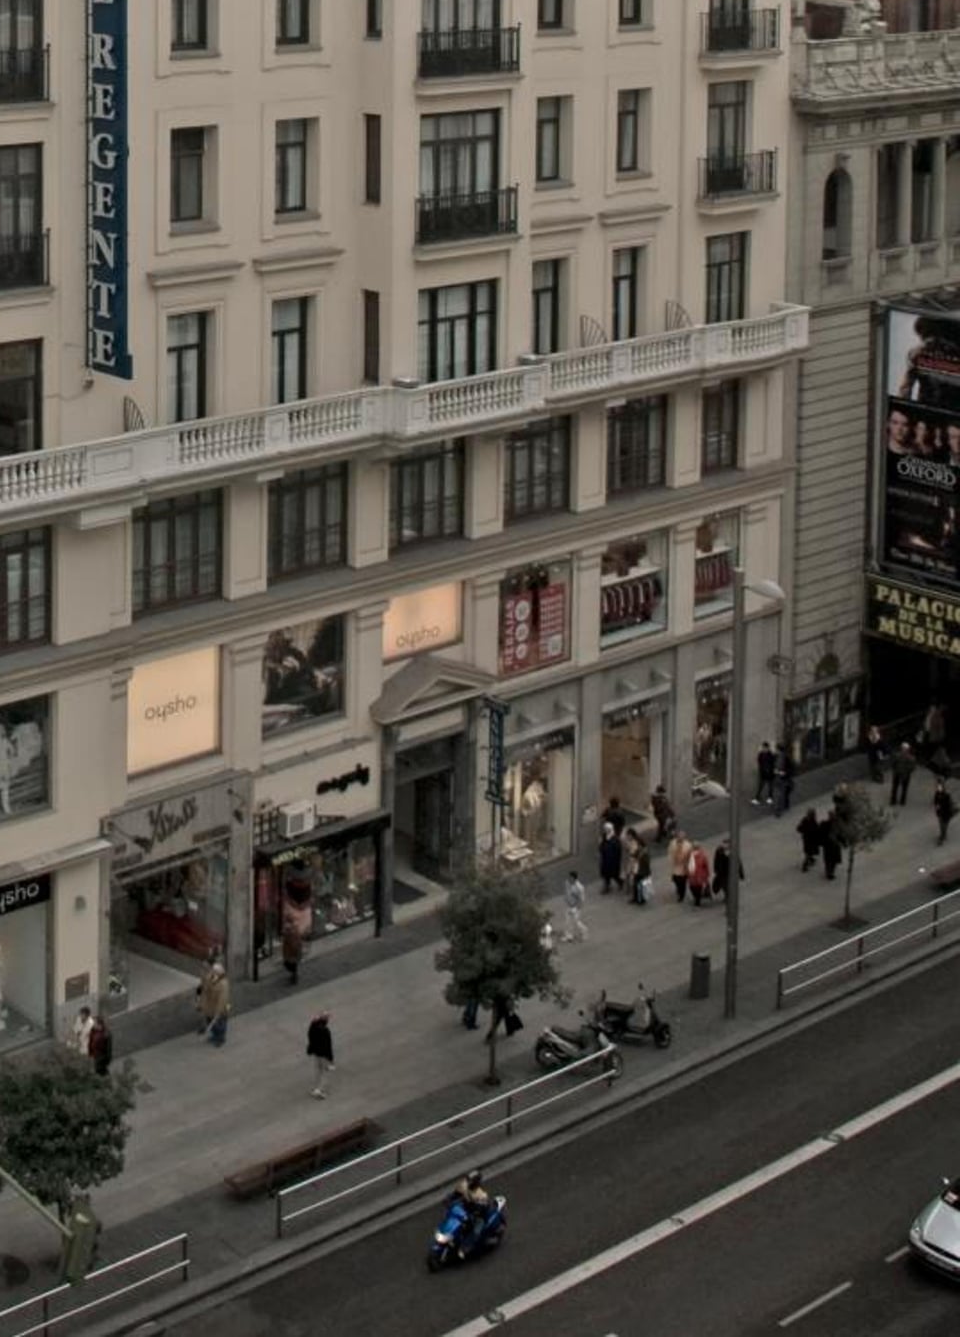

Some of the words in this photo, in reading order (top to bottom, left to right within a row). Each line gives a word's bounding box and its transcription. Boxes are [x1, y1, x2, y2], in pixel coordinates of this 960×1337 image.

[91, 33, 118, 368] REGENTE
[897, 461, 956, 486] OXFORD
[899, 608, 918, 624] DE
[926, 616, 944, 631] LA
[396, 625, 441, 648] oysho
[879, 616, 960, 655] MUSICA
[144, 694, 197, 723] oysho
